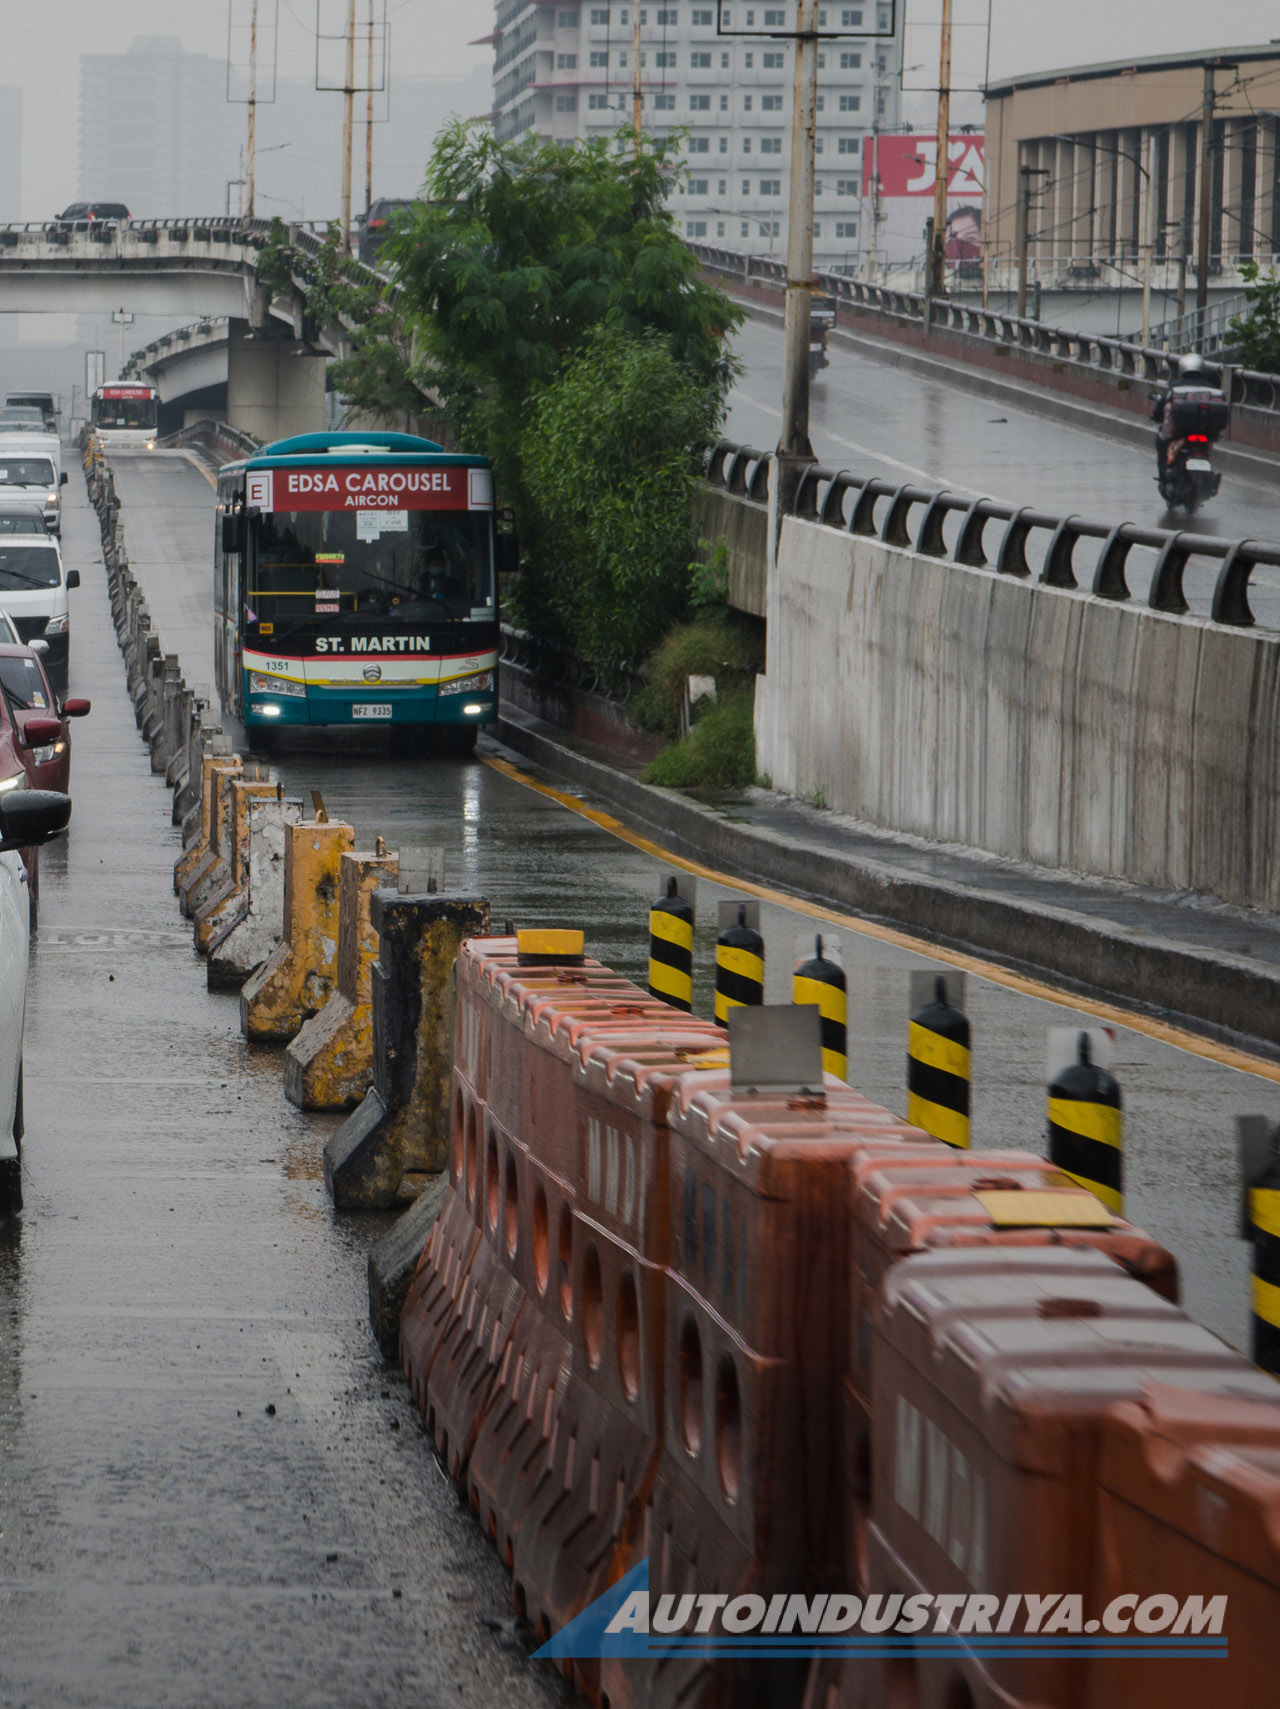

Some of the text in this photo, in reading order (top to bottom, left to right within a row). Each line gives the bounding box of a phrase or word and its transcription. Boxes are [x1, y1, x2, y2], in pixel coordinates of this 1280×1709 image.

[288, 473, 452, 493] EDSA CAROUSEL
[252, 484, 263, 499] E
[344, 495, 399, 506] AIRCON
[315, 636, 431, 652] ST. MARTIN
[265, 661, 289, 671] 1351
[353, 707, 392, 716] NFZ 9335
